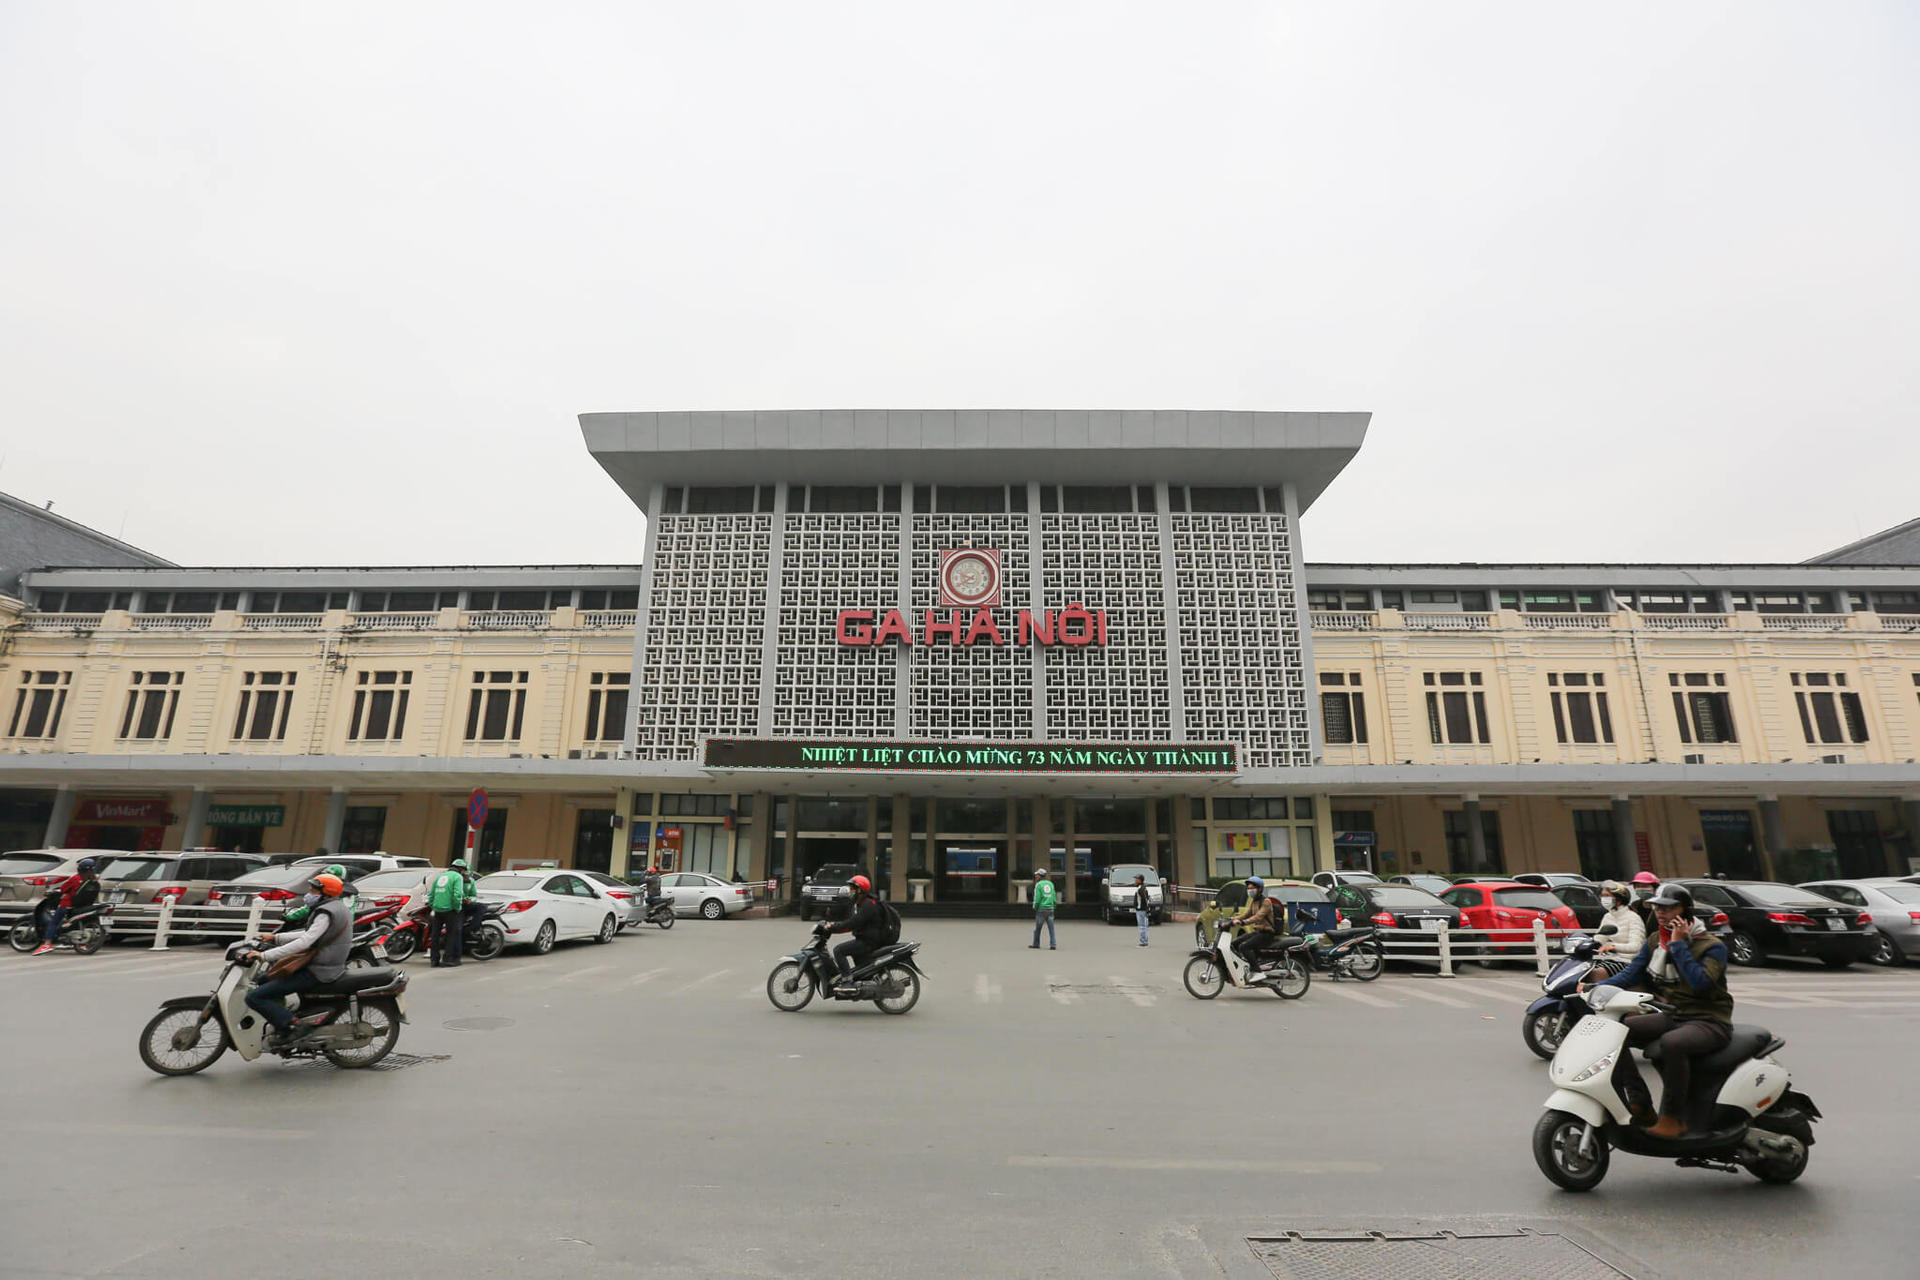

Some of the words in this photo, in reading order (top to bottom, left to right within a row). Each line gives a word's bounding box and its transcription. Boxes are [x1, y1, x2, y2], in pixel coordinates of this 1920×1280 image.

[837, 609, 913, 645] GA
[925, 604, 1004, 646] HÀ
[1018, 602, 1107, 648] NỘI
[862, 747, 904, 766] LIỆT
[966, 747, 1023, 764] MỪNG
[1027, 751, 1046, 765] 73
[1050, 748, 1093, 765] NĂM
[1097, 748, 1149, 765] NGÀY
